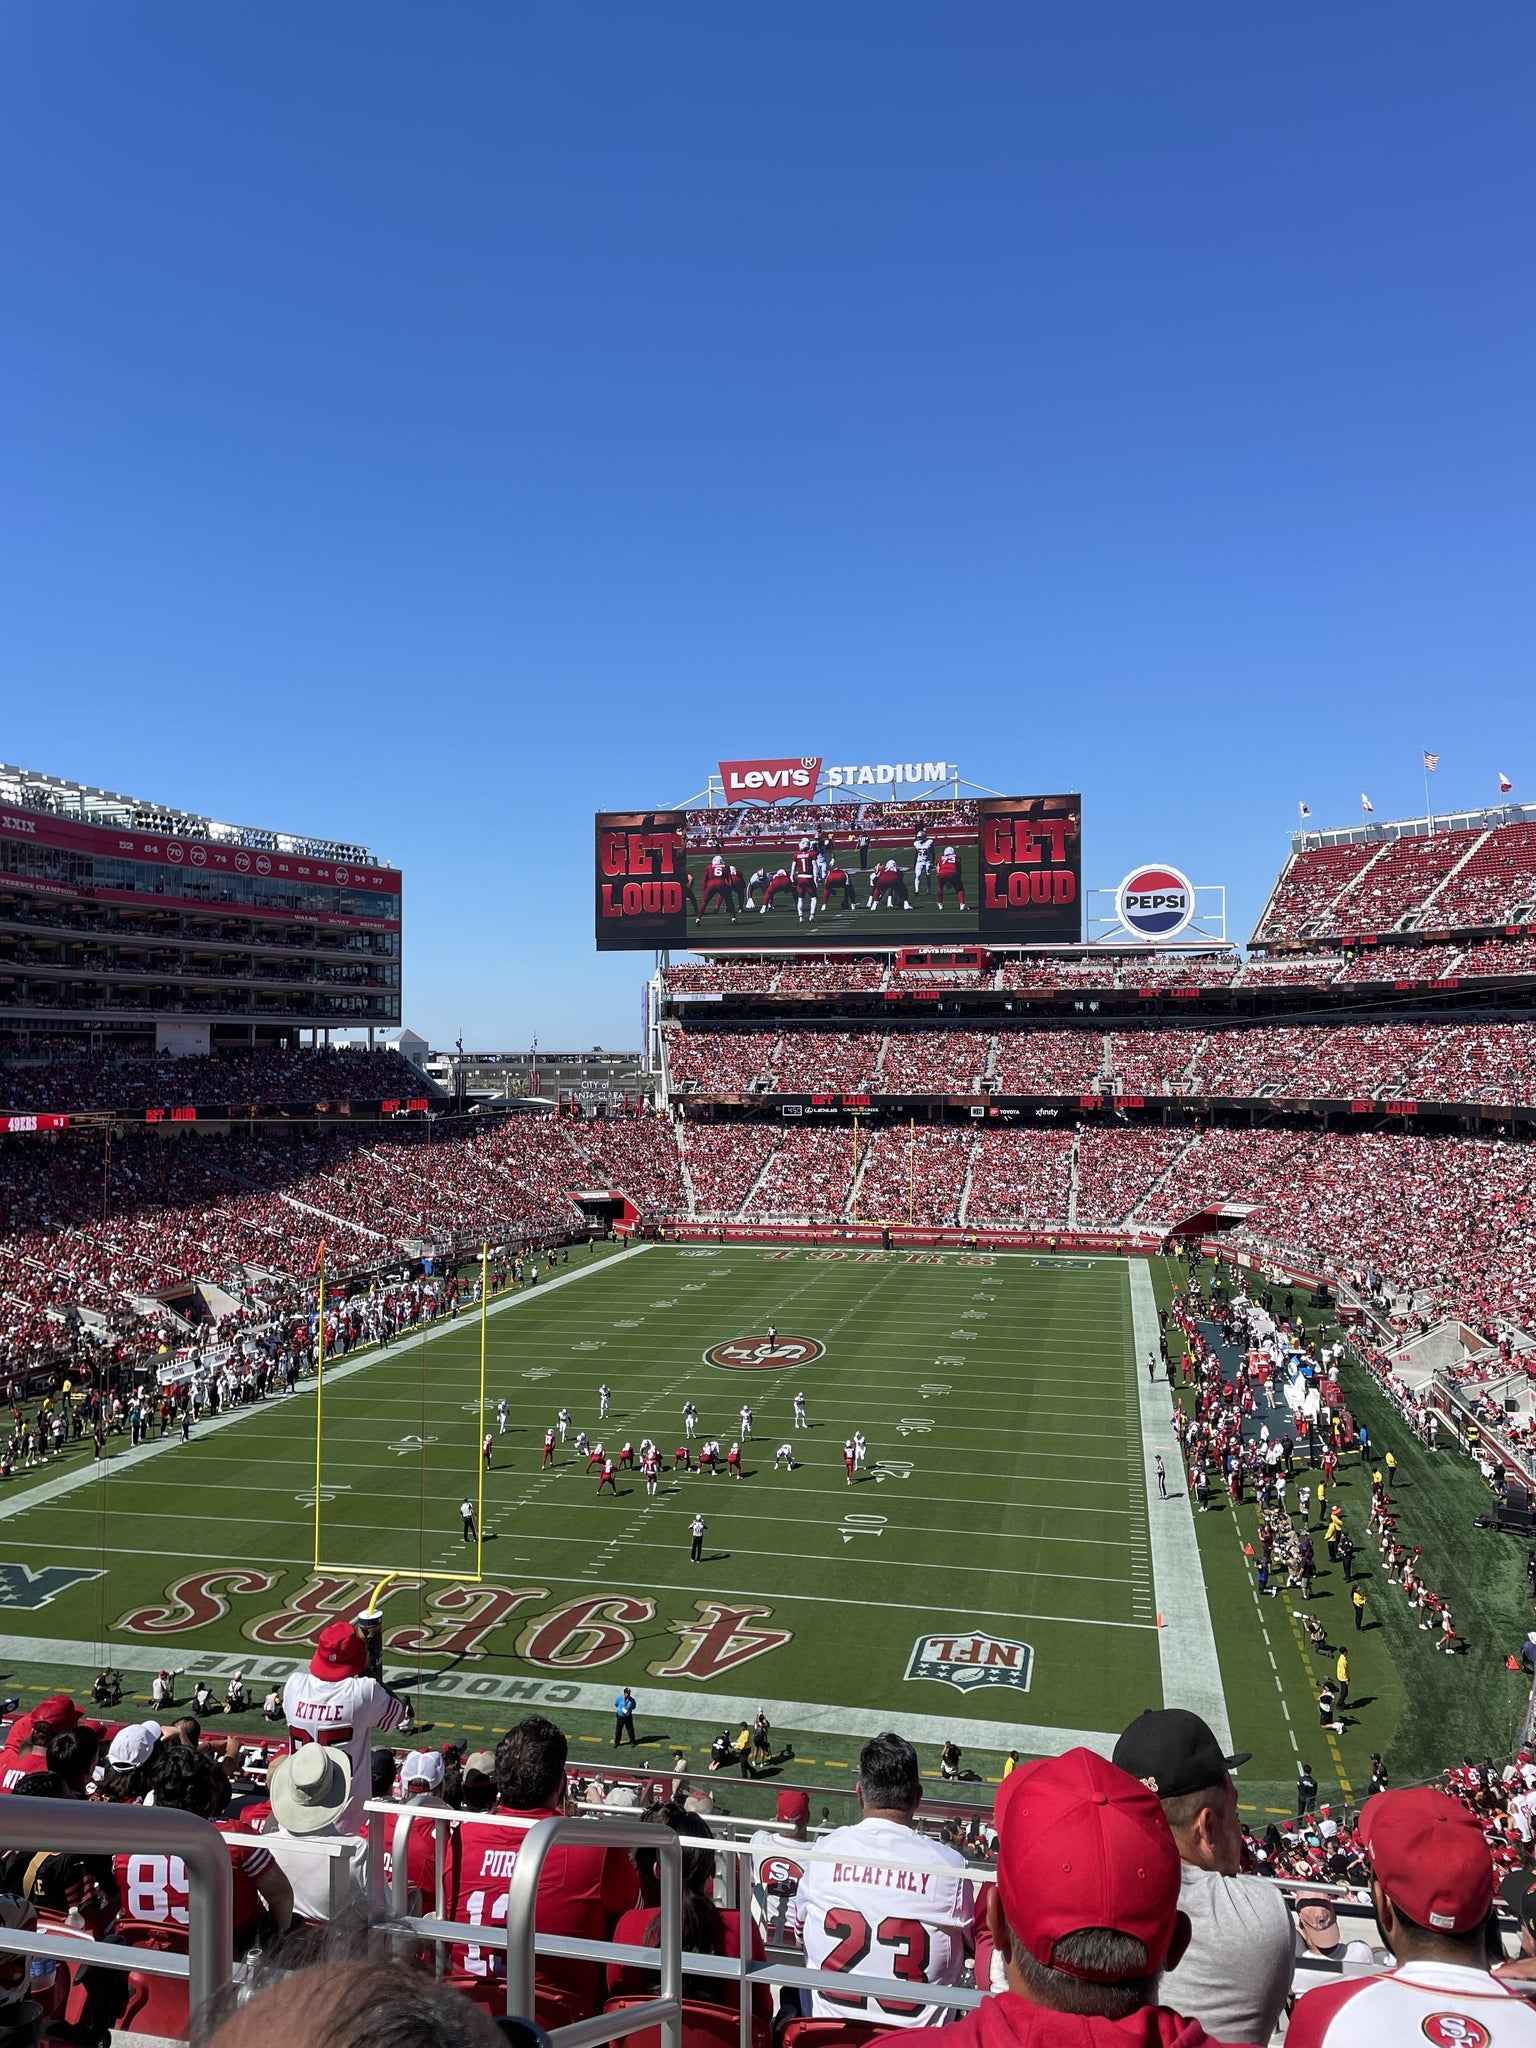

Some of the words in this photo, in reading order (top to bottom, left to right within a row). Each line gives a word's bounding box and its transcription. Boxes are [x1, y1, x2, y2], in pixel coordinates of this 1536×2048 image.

[828, 762, 947, 787] STADIUM
[2, 816, 36, 834] XXIX
[984, 817, 1076, 866] GET
[119, 841, 134, 850] 52
[168, 848, 182, 857] 70
[192, 852, 205, 860] 73
[214, 854, 228, 863] 74
[236, 858, 250, 866] 79
[600, 832, 682, 877] GET
[801, 858, 806, 873] 1
[601, 882, 682, 918] LOUD
[984, 870, 1076, 909] LOUD
[1126, 894, 1186, 910] PEPSI
[568, 1092, 594, 1100] SANTA
[582, 1080, 598, 1090] CITY
[601, 1080, 610, 1089] of
[8, 1116, 38, 1132] 49ERS
[1036, 1108, 1059, 1118] xfinity
[756, 1250, 997, 1267] 49ERS
[896, 1418, 936, 1432] 30
[870, 1460, 915, 1479] 20
[837, 1514, 888, 1537] 10
[106, 1567, 794, 1681] 49ERS
[930, 1638, 1021, 1668] NFL
[187, 1654, 299, 1678] OVE
[295, 1700, 344, 1721] KITTLE
[480, 1850, 520, 1878] PUR
[832, 1862, 931, 1895] McCAFFREY
[818, 1906, 930, 2018] 23
